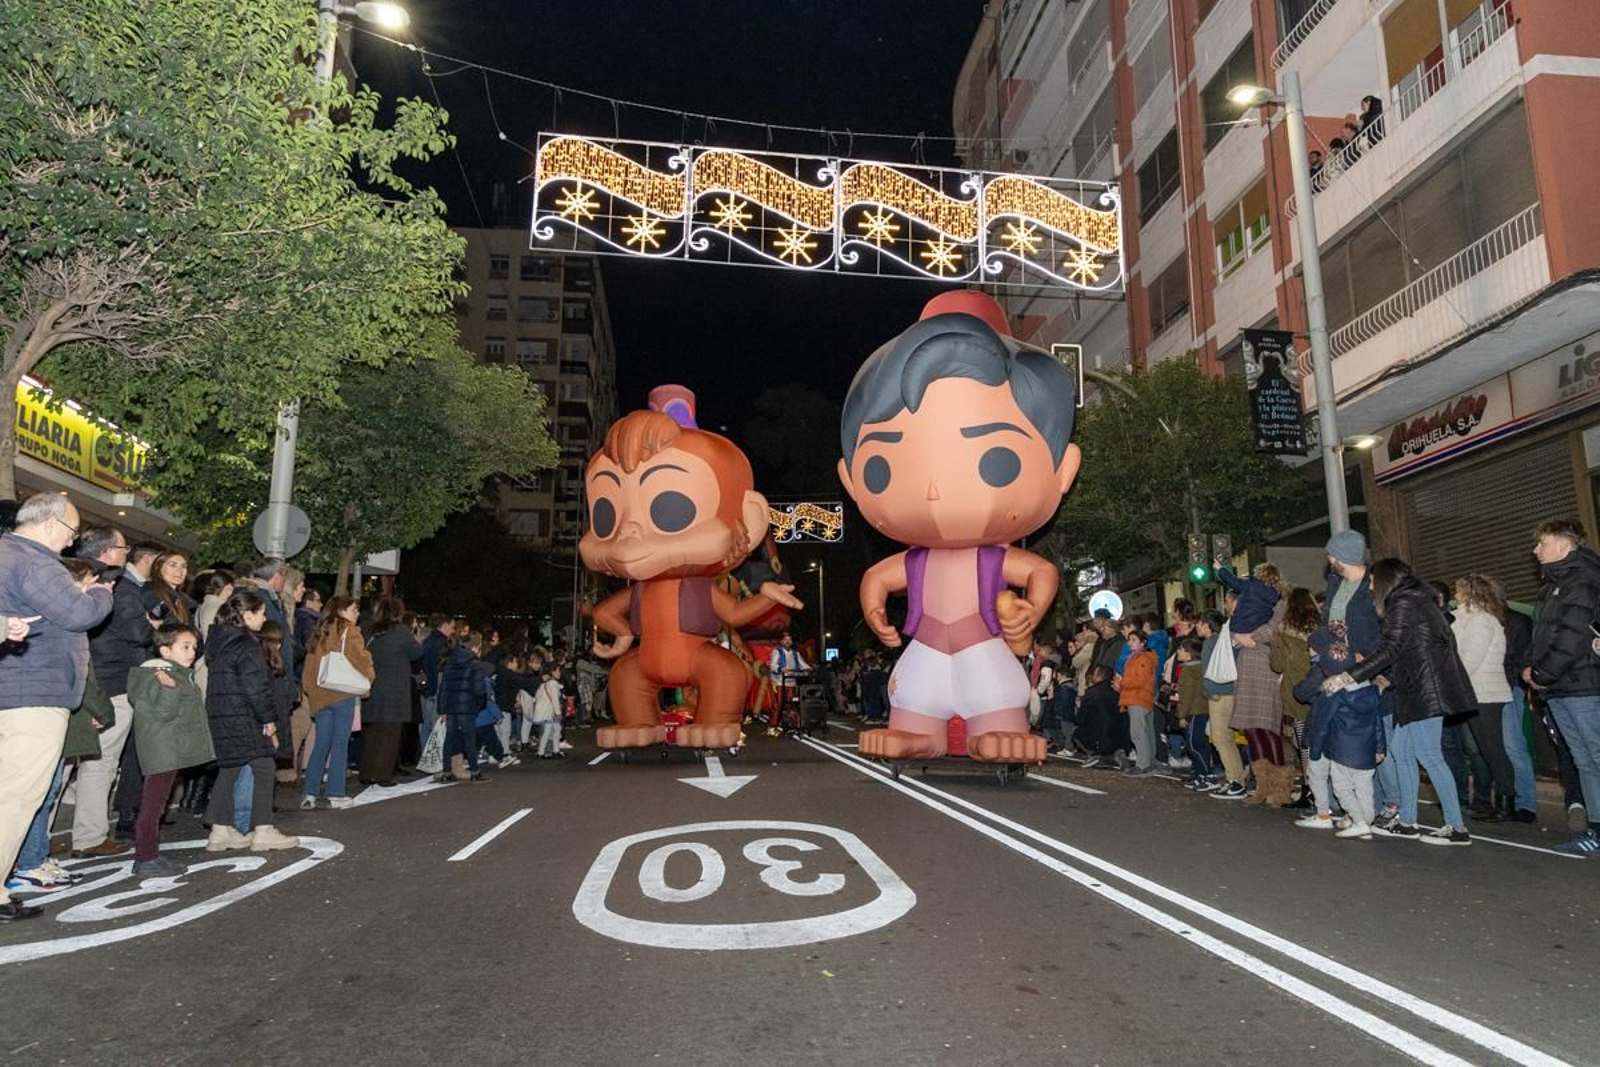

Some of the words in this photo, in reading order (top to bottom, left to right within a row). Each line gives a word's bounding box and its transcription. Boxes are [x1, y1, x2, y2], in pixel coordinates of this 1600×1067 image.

[14, 431, 48, 457] RUPO
[16, 402, 82, 456] LIARIA
[638, 838, 846, 902] 30
